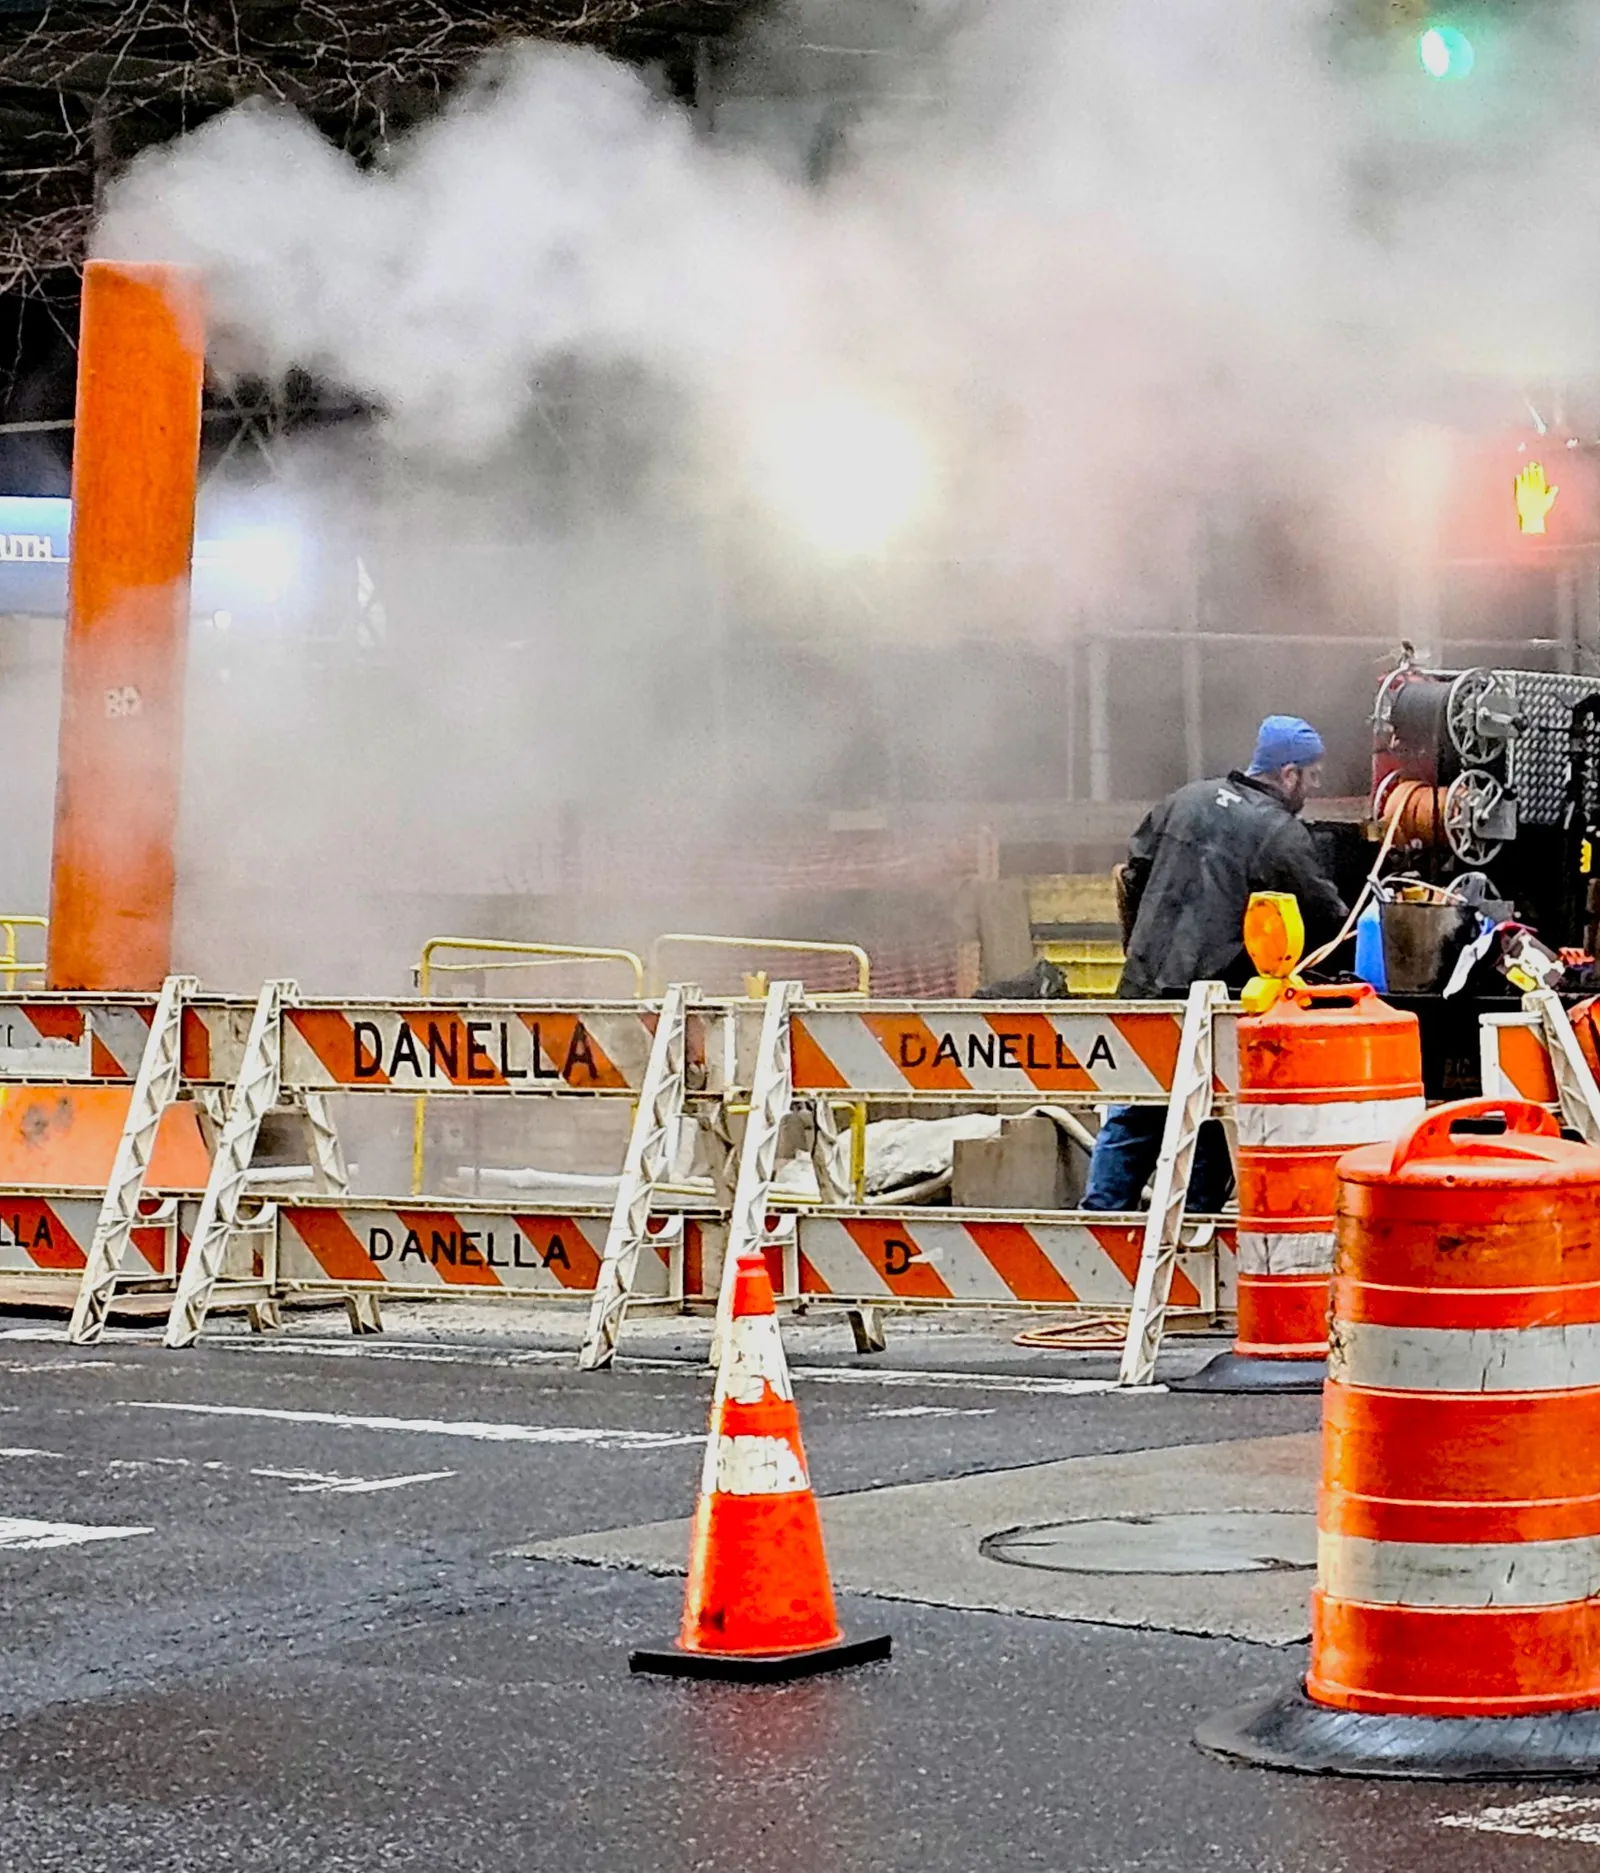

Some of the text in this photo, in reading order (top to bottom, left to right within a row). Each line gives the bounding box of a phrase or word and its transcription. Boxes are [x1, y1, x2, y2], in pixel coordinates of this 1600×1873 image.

[353, 1021, 599, 1081] DANELLA
[899, 1033, 1117, 1070] DANELLA
[368, 1227, 572, 1270] DANELLA
